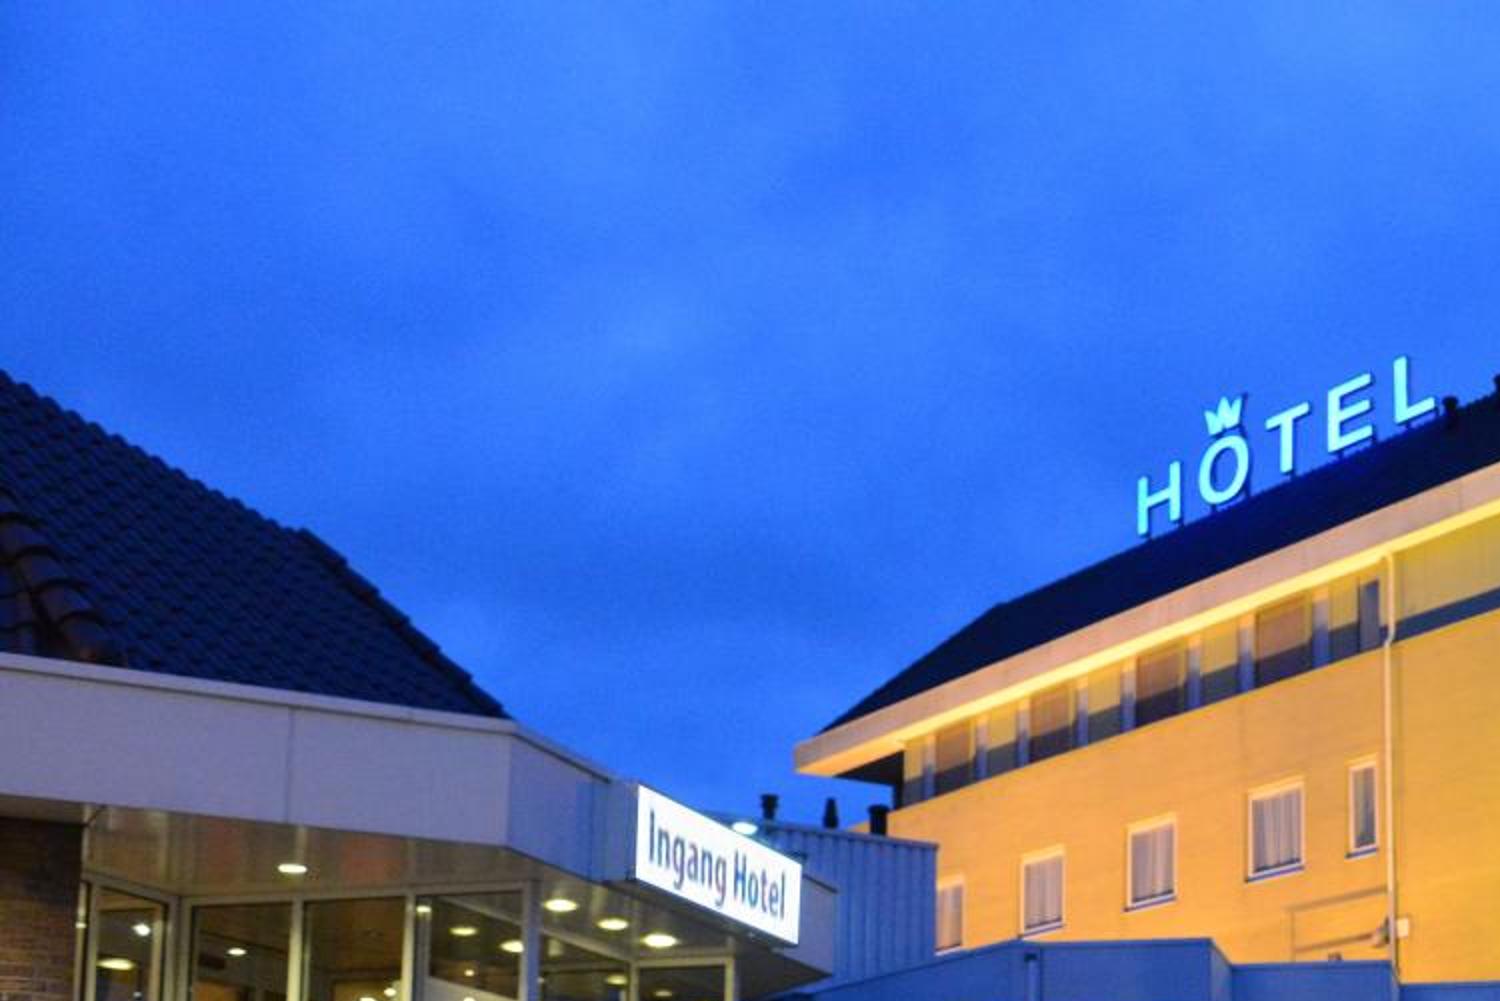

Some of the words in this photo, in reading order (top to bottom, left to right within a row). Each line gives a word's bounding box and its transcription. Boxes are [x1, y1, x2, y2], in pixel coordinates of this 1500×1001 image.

[1136, 355, 1436, 536] HOTEL
[648, 807, 727, 907] Ingang
[733, 848, 786, 921] Hotel
